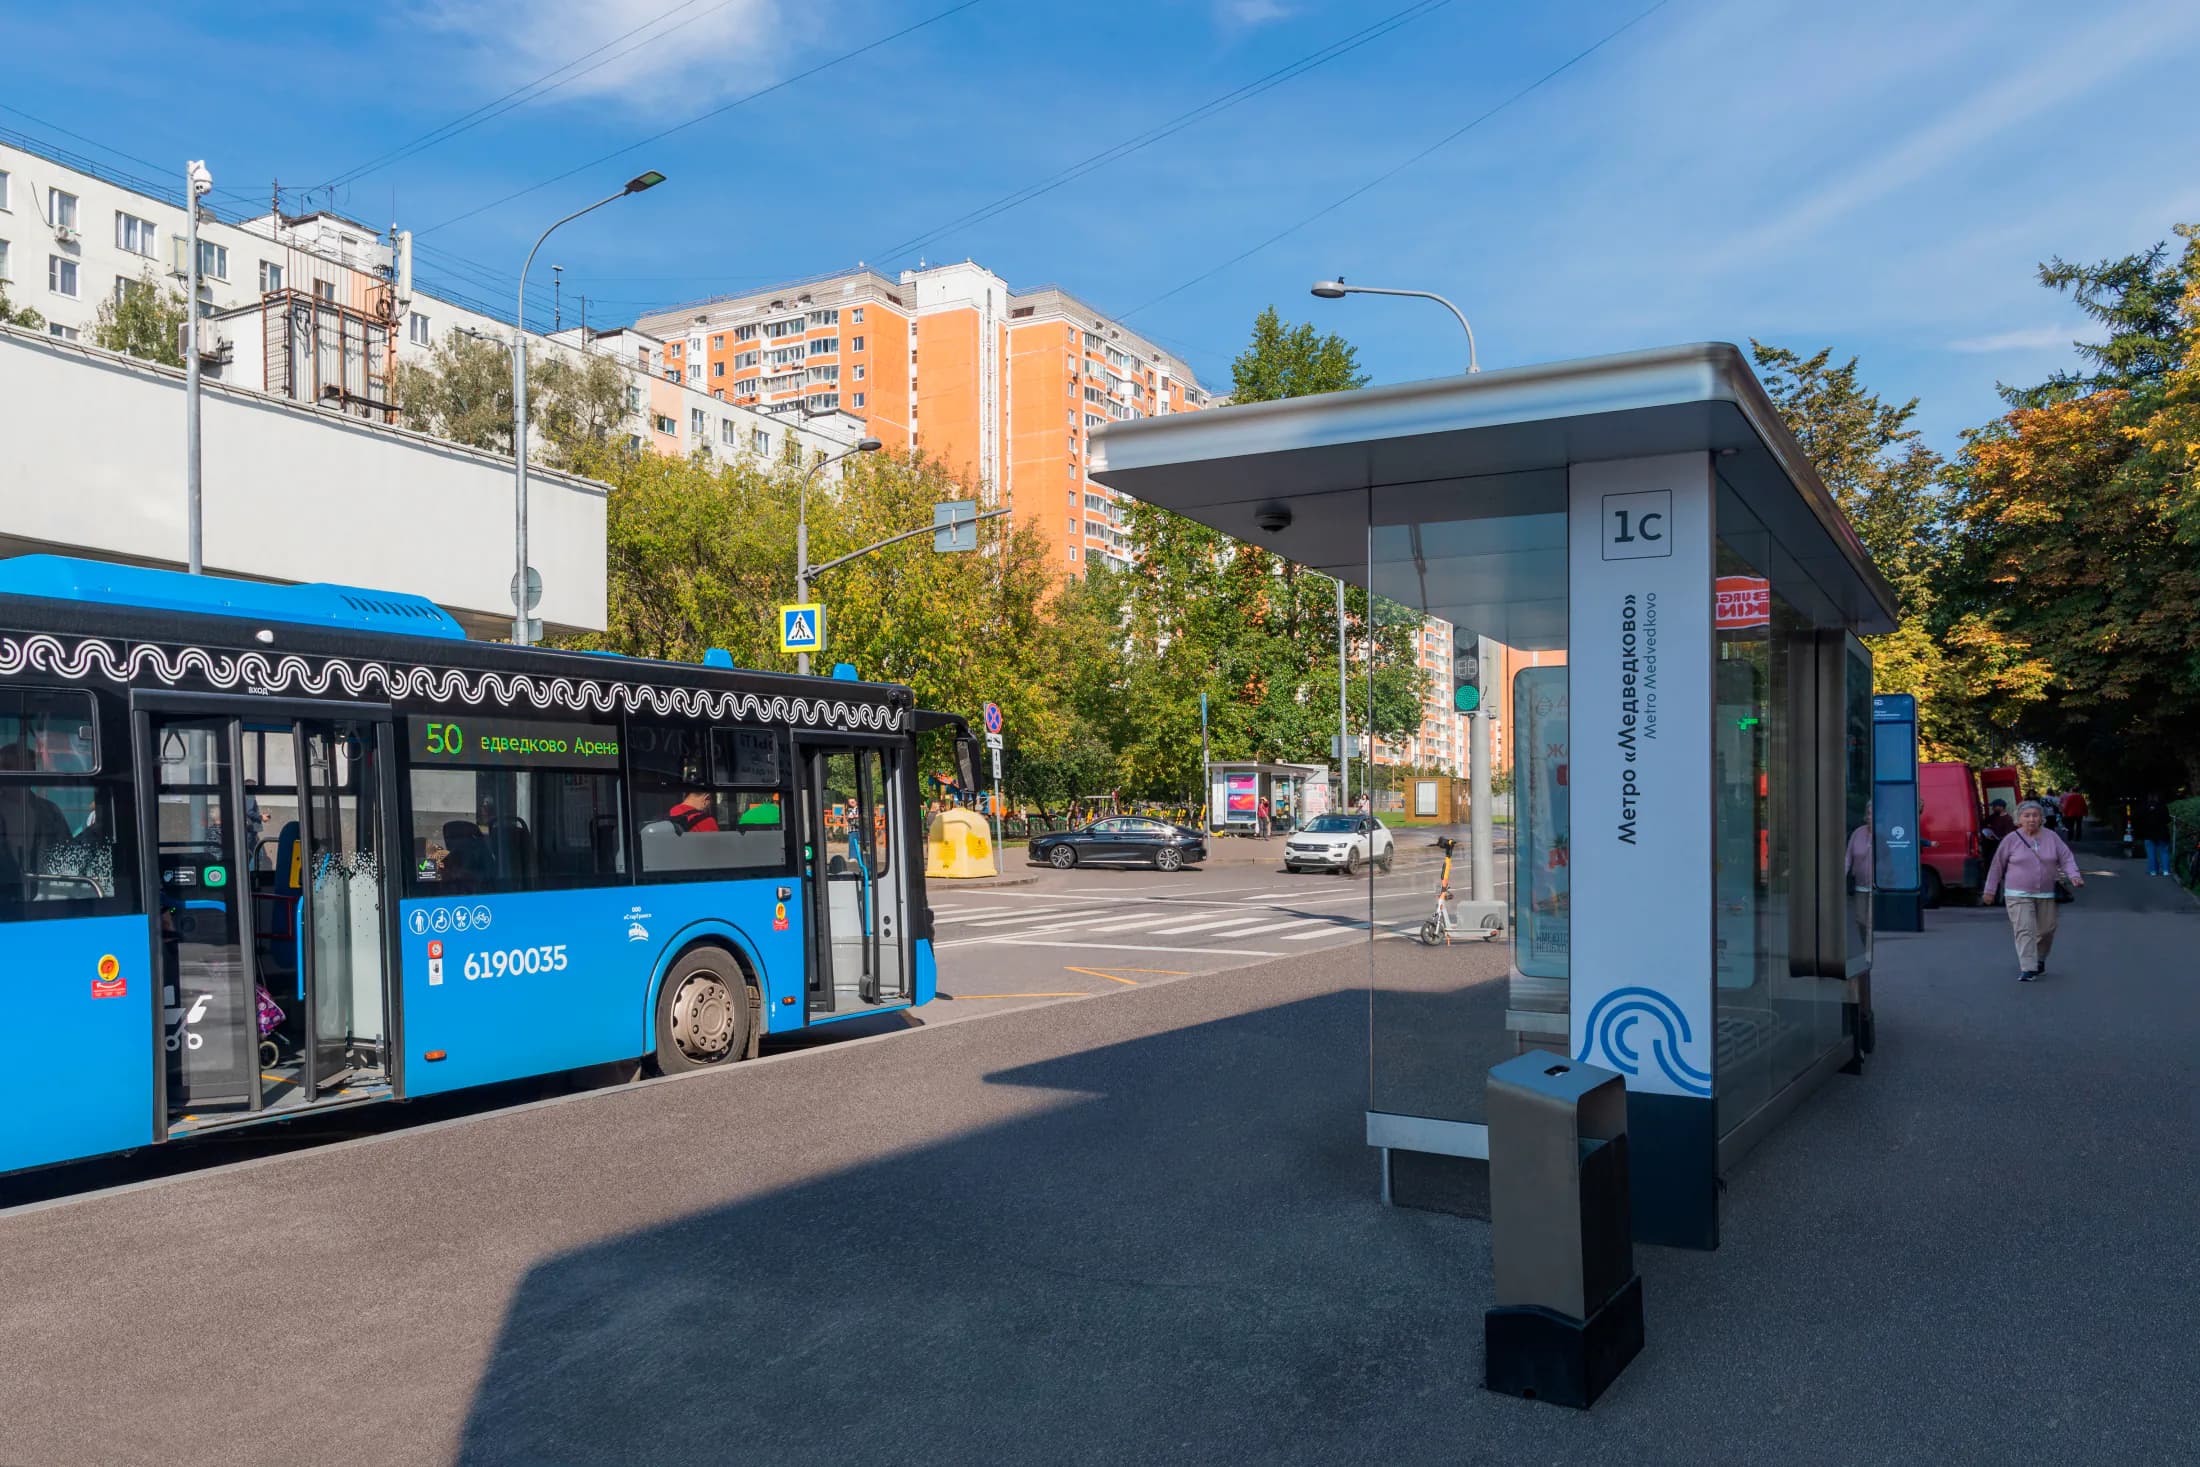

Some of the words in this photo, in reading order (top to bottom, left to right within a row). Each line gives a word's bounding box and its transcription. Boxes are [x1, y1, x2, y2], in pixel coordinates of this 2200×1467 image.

[1643, 592, 1657, 690] Medvedkovo
[1618, 594, 1639, 763] «Медведково»
[426, 723, 463, 754] 50
[481, 735, 568, 754] едведково
[574, 736, 619, 757] Арена
[1644, 693, 1657, 740] Metro
[1618, 769, 1640, 845] Метро
[464, 945, 568, 981] 6190035
